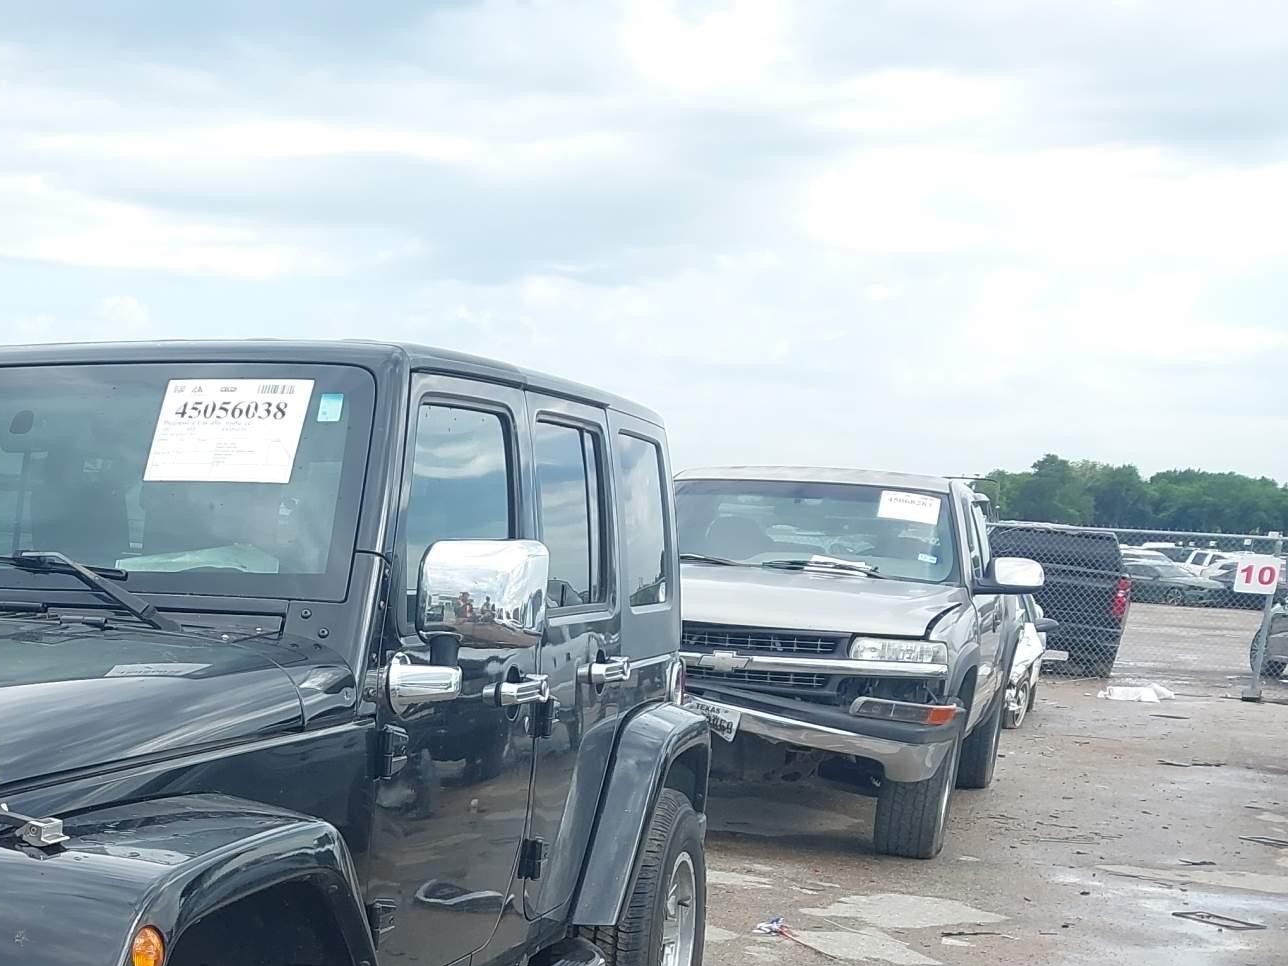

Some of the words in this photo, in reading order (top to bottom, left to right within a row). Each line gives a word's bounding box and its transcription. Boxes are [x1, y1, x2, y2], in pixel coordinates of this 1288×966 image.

[175, 400, 288, 420] 45056038
[1240, 564, 1276, 586] 10
[696, 702, 721, 714] TEXAS
